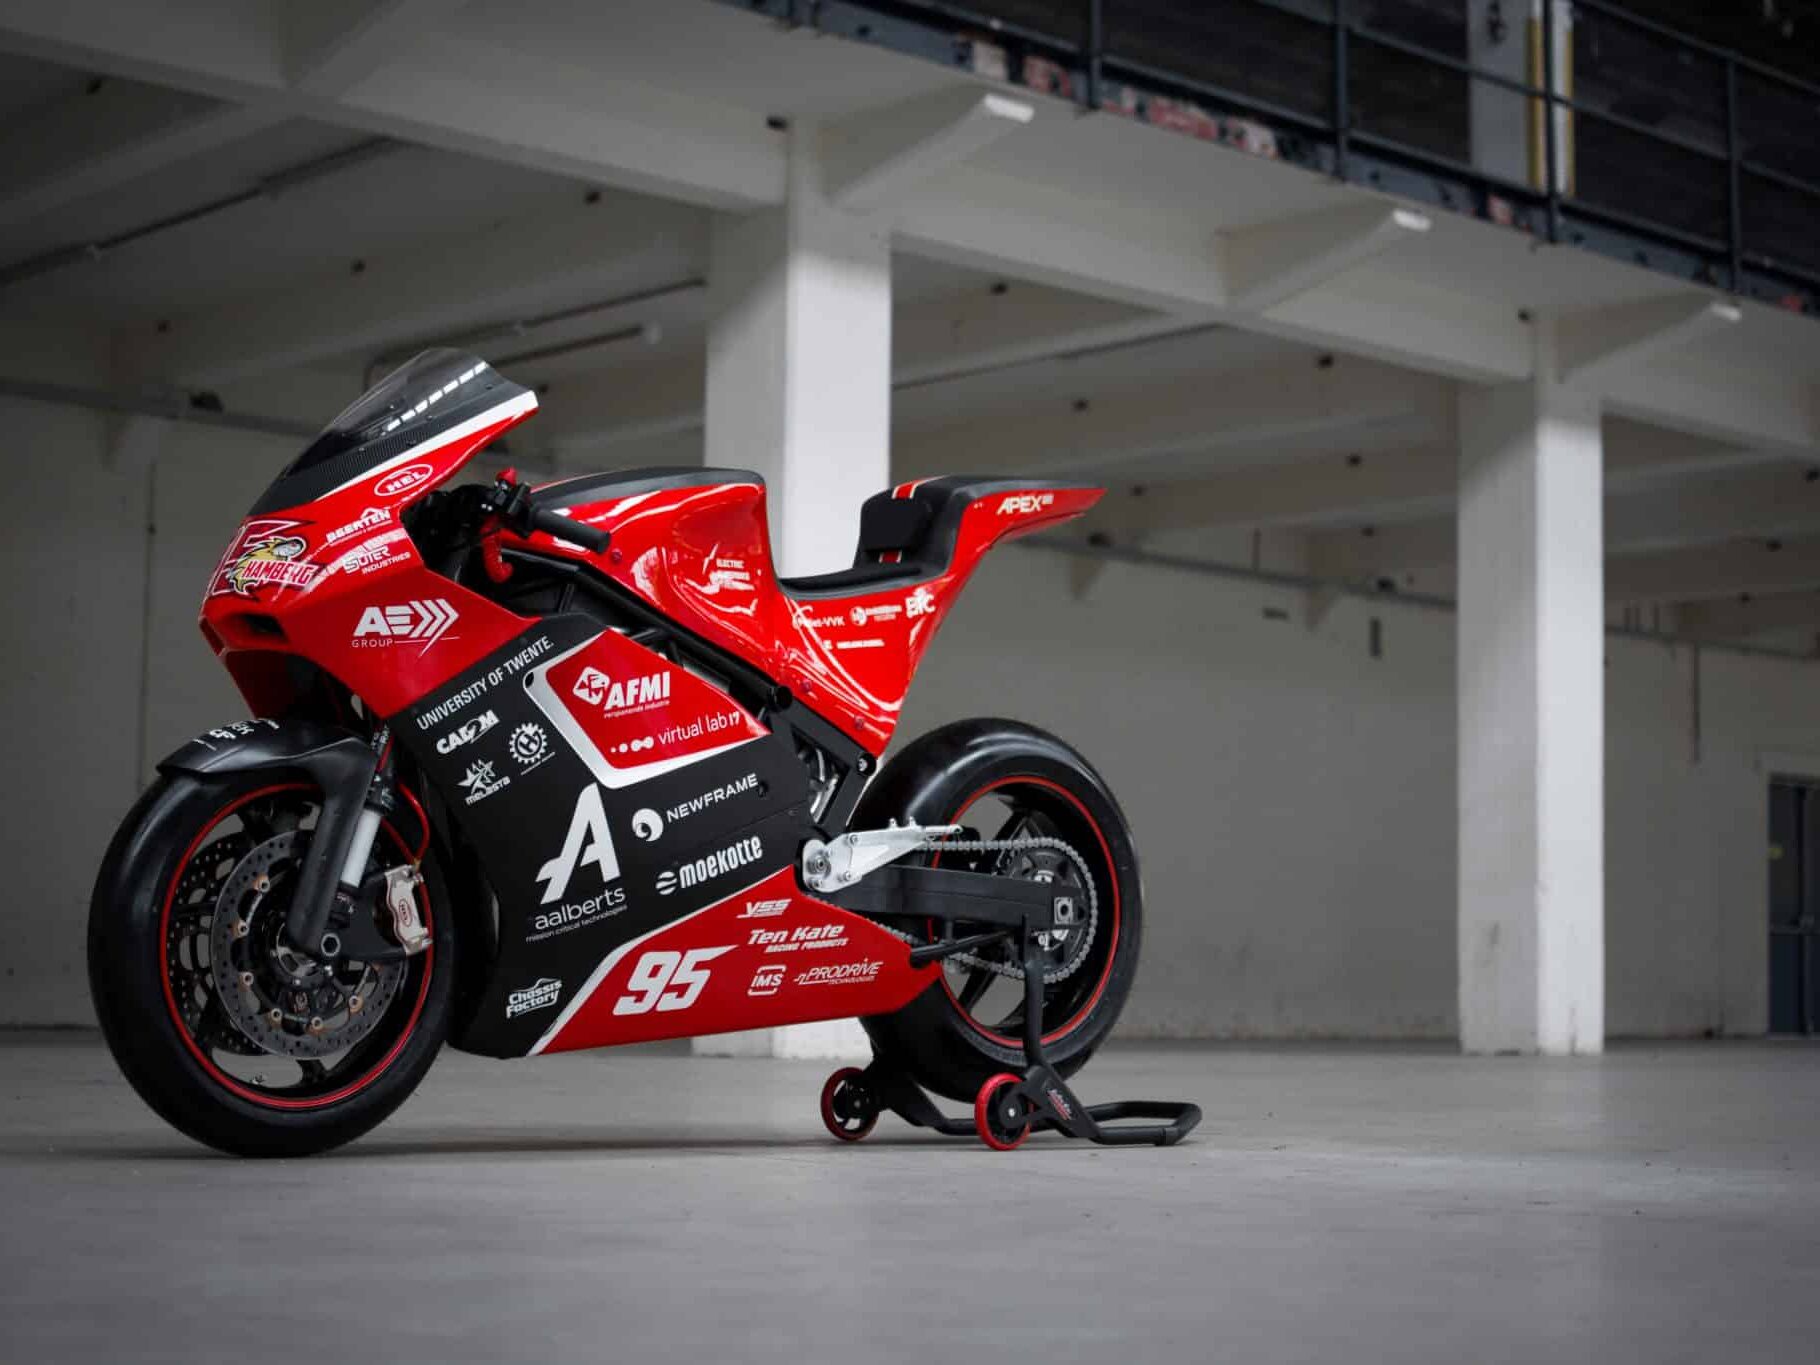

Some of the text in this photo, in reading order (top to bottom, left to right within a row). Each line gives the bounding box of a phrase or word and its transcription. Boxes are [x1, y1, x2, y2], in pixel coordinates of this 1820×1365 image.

[386, 471, 426, 493] HEL
[996, 495, 1042, 515] APEX
[342, 545, 390, 574] SUTER
[361, 551, 412, 574] INDUSTRIES
[243, 559, 320, 587] HAMBERG
[351, 637, 394, 649] GROUP
[416, 678, 488, 730] UNIVERSITY
[488, 668, 504, 687] OF
[604, 671, 671, 711] AFMI
[658, 716, 703, 746] virtual
[667, 772, 759, 823] NEWFRAME
[534, 887, 627, 930] aalberts
[748, 924, 845, 945] Ten Kate
[801, 937, 849, 951] PRODUCTS
[613, 945, 739, 1016] 95
[751, 973, 784, 988] IMS
[806, 958, 884, 981] PRODRIVE
[506, 989, 559, 1018] Factory
[509, 980, 562, 1005] Chassis
